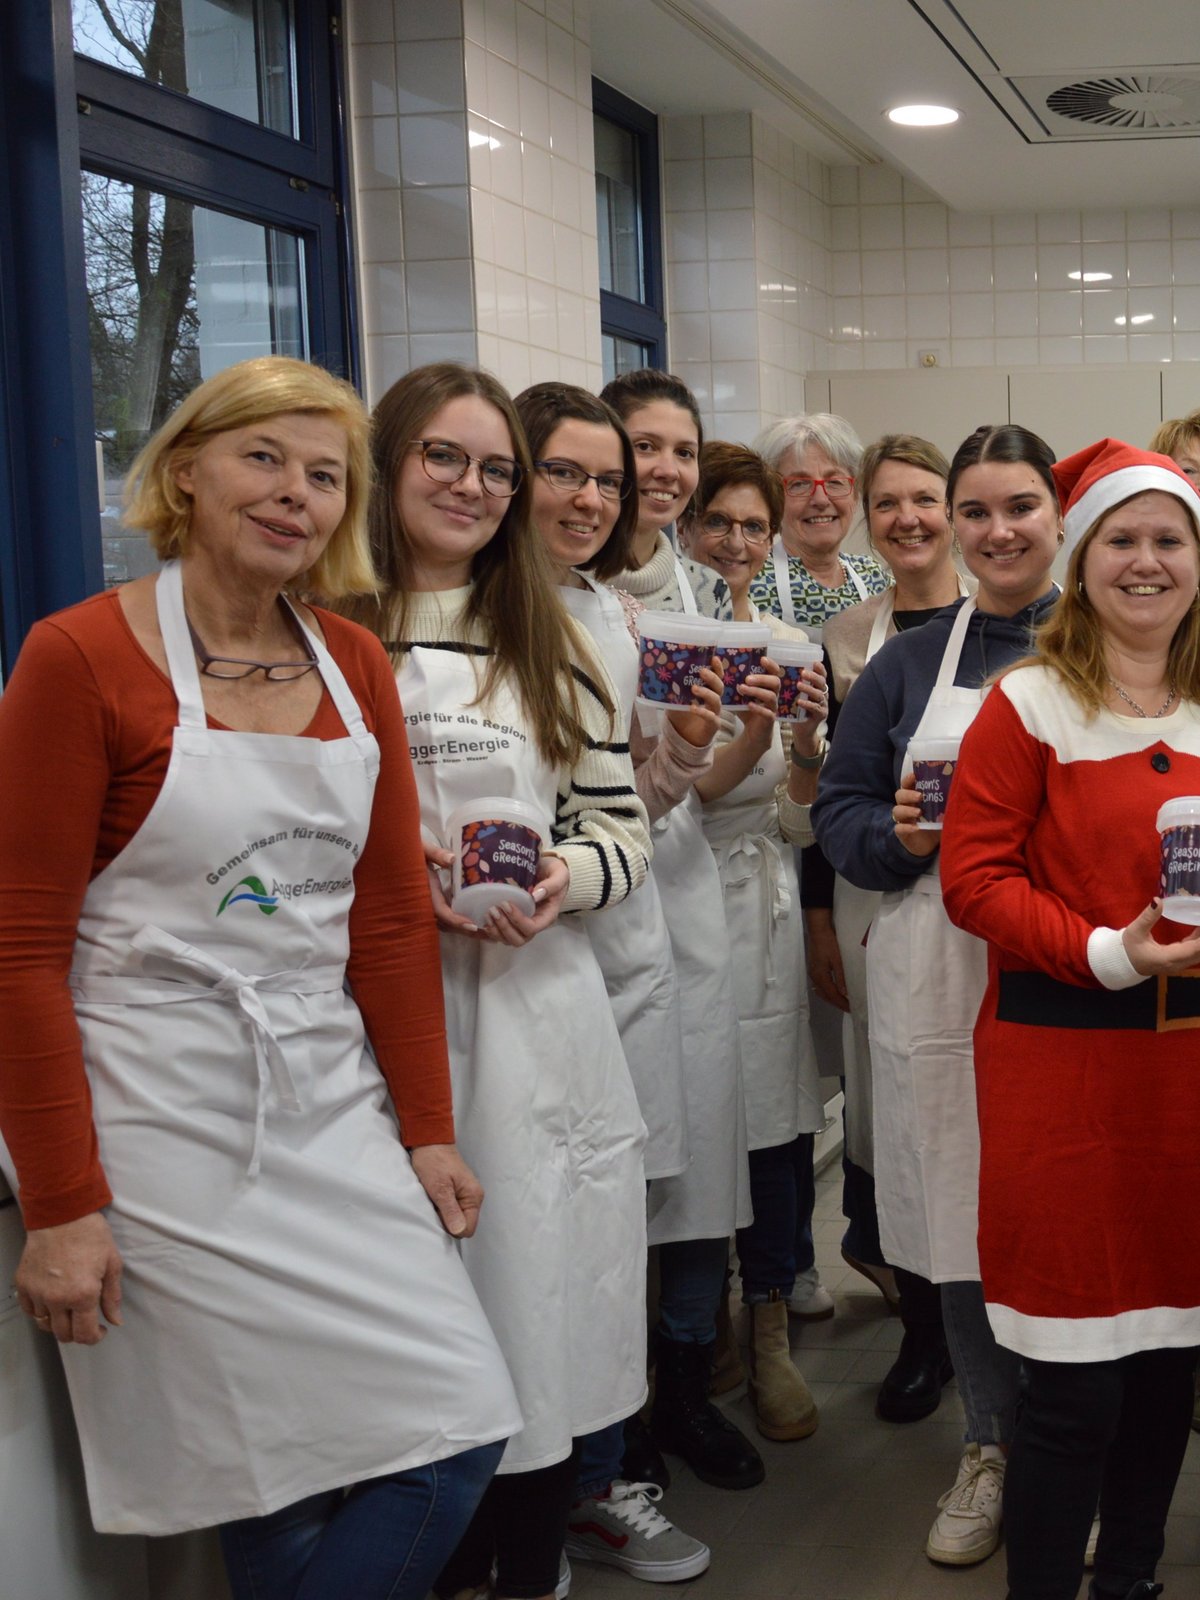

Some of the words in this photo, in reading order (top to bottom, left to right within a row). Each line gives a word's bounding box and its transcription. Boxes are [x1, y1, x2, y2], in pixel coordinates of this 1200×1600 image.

[404, 711, 432, 726] rgie
[433, 712, 453, 723] für
[457, 714, 478, 726] die
[482, 719, 527, 742] Region
[408, 737, 510, 759] ggerEnergie
[206, 830, 288, 885] Gemeinsam
[292, 827, 314, 839] für
[315, 832, 352, 850] unsere
